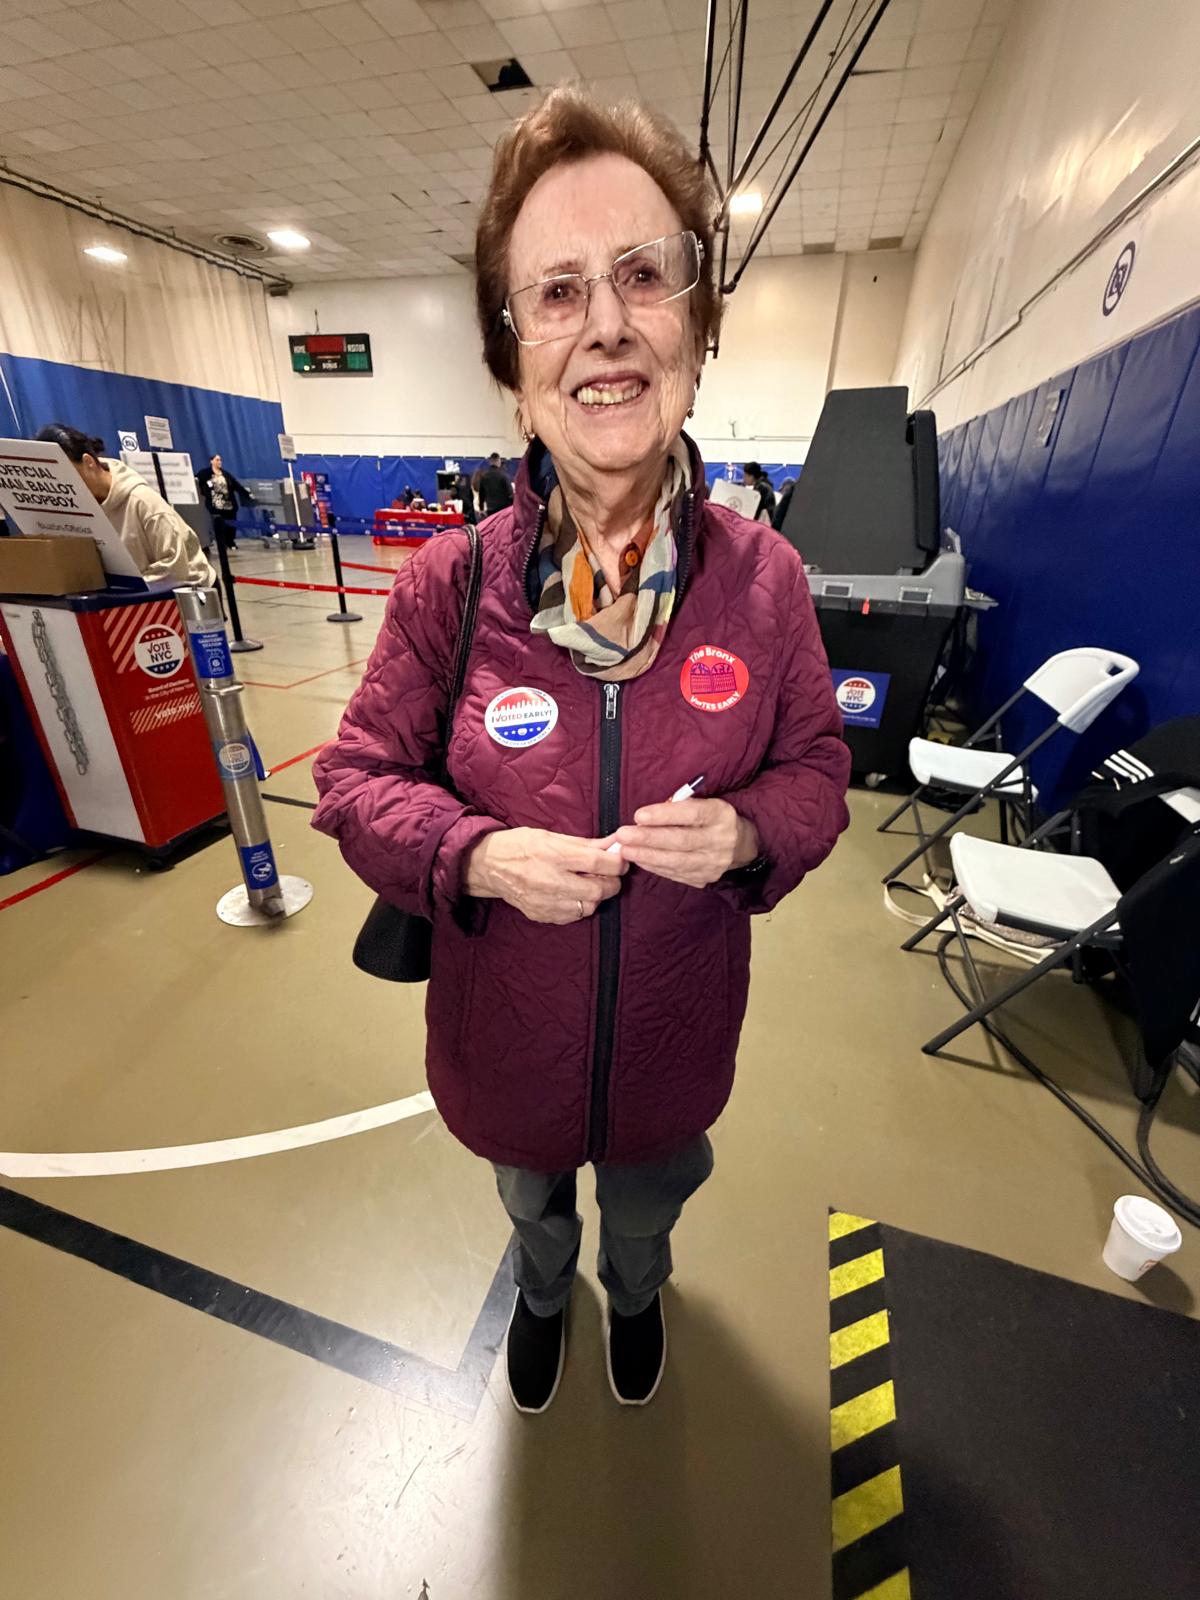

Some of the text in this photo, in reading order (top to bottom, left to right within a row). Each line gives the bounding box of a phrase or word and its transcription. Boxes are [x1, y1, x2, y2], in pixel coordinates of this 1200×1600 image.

[0, 464, 56, 480] OFFICIAL
[0, 478, 77, 495] MAIL BALLOT
[12, 492, 79, 508] DROPBOX
[147, 641, 171, 654] VOTE
[689, 647, 736, 664] The Bronx
[150, 650, 173, 663] NYC
[717, 690, 740, 710] EARLY
[155, 701, 195, 720] vote.nyc
[495, 713, 522, 723] VOTED
[524, 710, 552, 719] EARLY!
